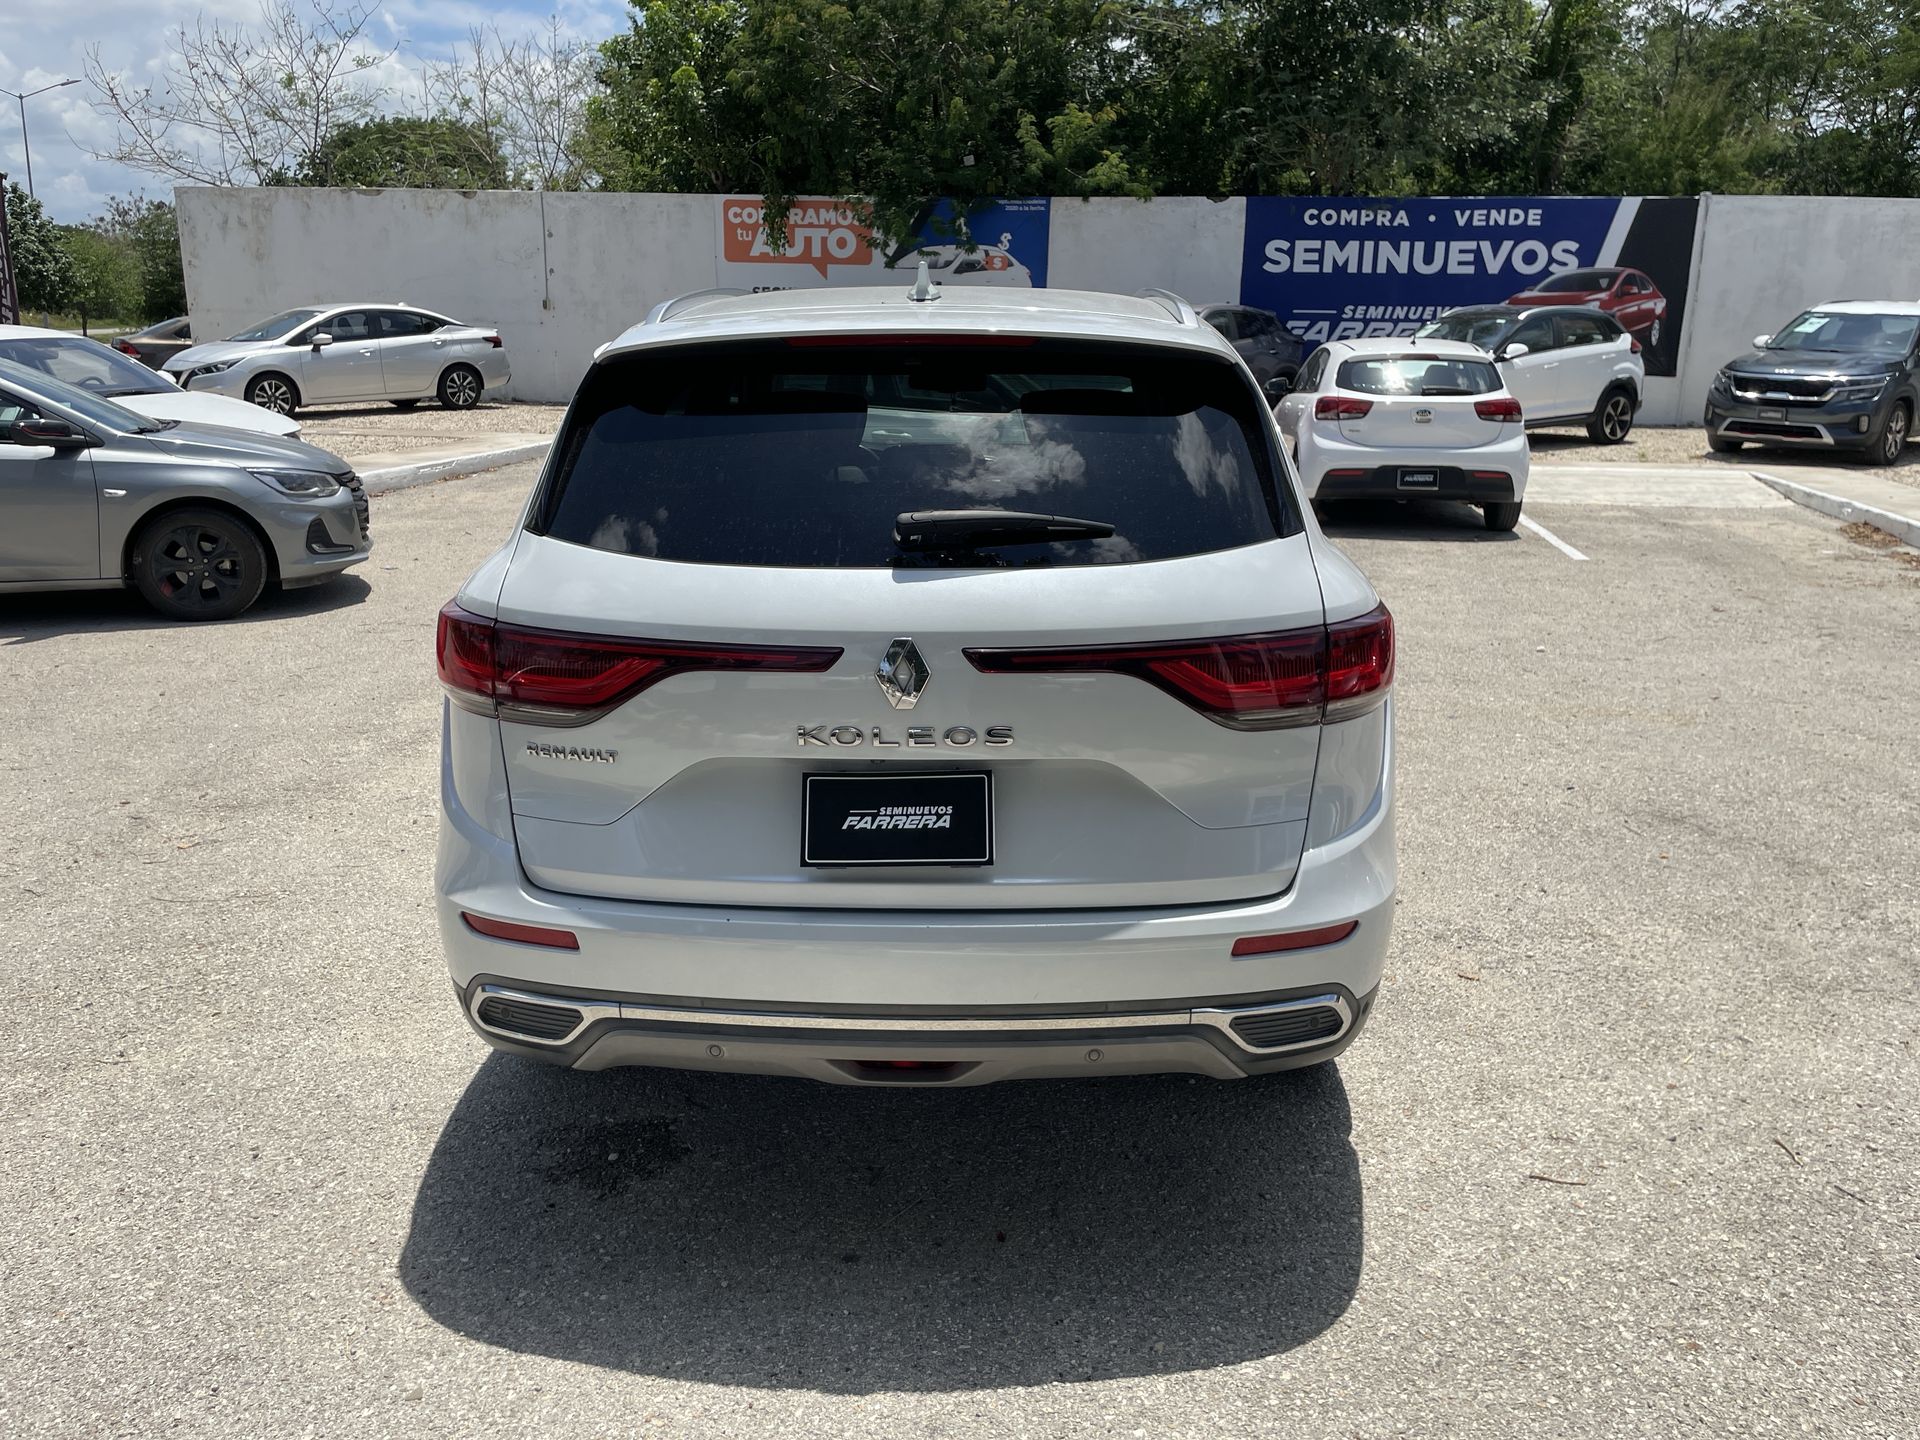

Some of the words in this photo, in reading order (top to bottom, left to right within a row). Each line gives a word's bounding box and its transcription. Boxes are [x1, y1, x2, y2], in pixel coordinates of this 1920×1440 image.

[1303, 208, 1410, 226] COMPRA
[1454, 209, 1543, 226] VENDE
[736, 228, 752, 241] tu
[750, 227, 857, 259] AUTO
[1262, 239, 1580, 276] SEMINUEVOS
[1341, 304, 1464, 320] SEMINUEV
[797, 724, 1015, 748] KOLEOS
[526, 740, 618, 764] RENAULT
[879, 806, 953, 816] SEMINUEVOS
[841, 815, 951, 830] FARRERA
